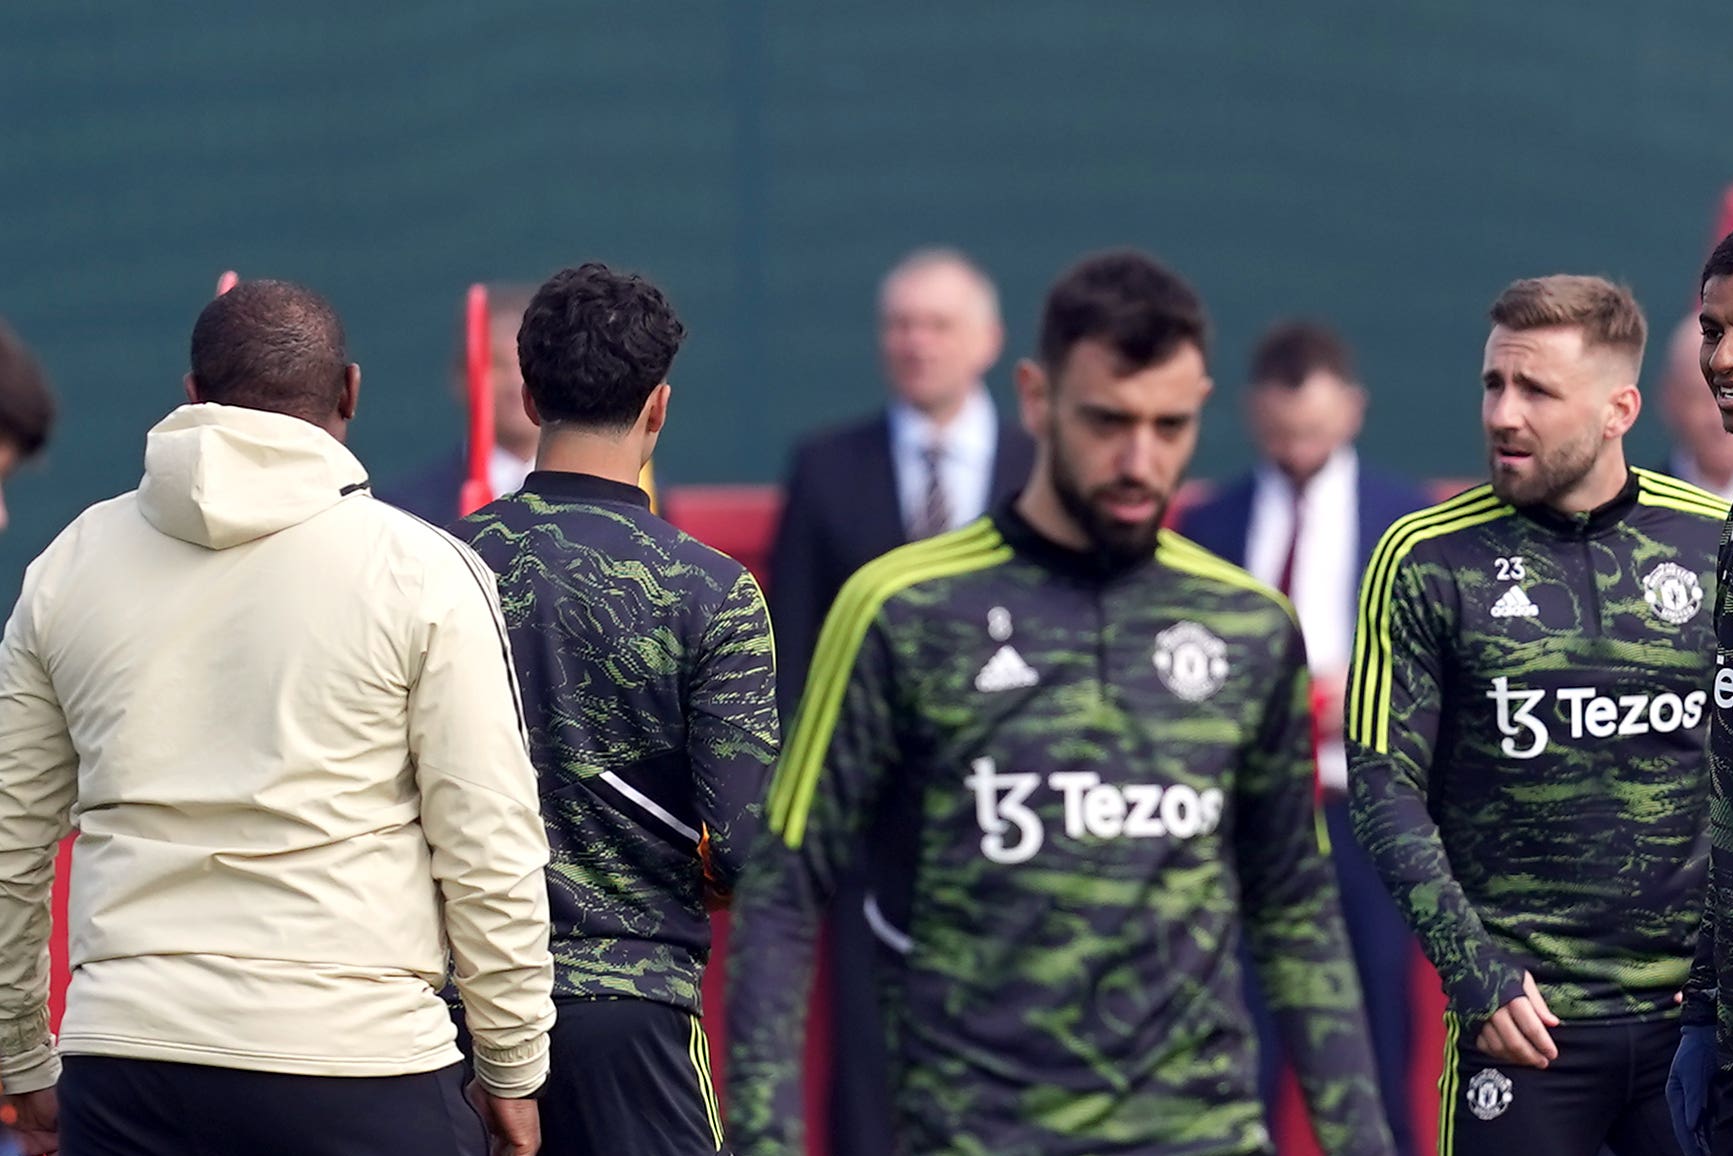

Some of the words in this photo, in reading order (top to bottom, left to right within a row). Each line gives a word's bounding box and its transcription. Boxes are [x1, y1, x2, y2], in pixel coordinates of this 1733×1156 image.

[1494, 556, 1526, 581] 23
[1557, 687, 1707, 739] Tezos
[1048, 771, 1224, 839] Tezos
